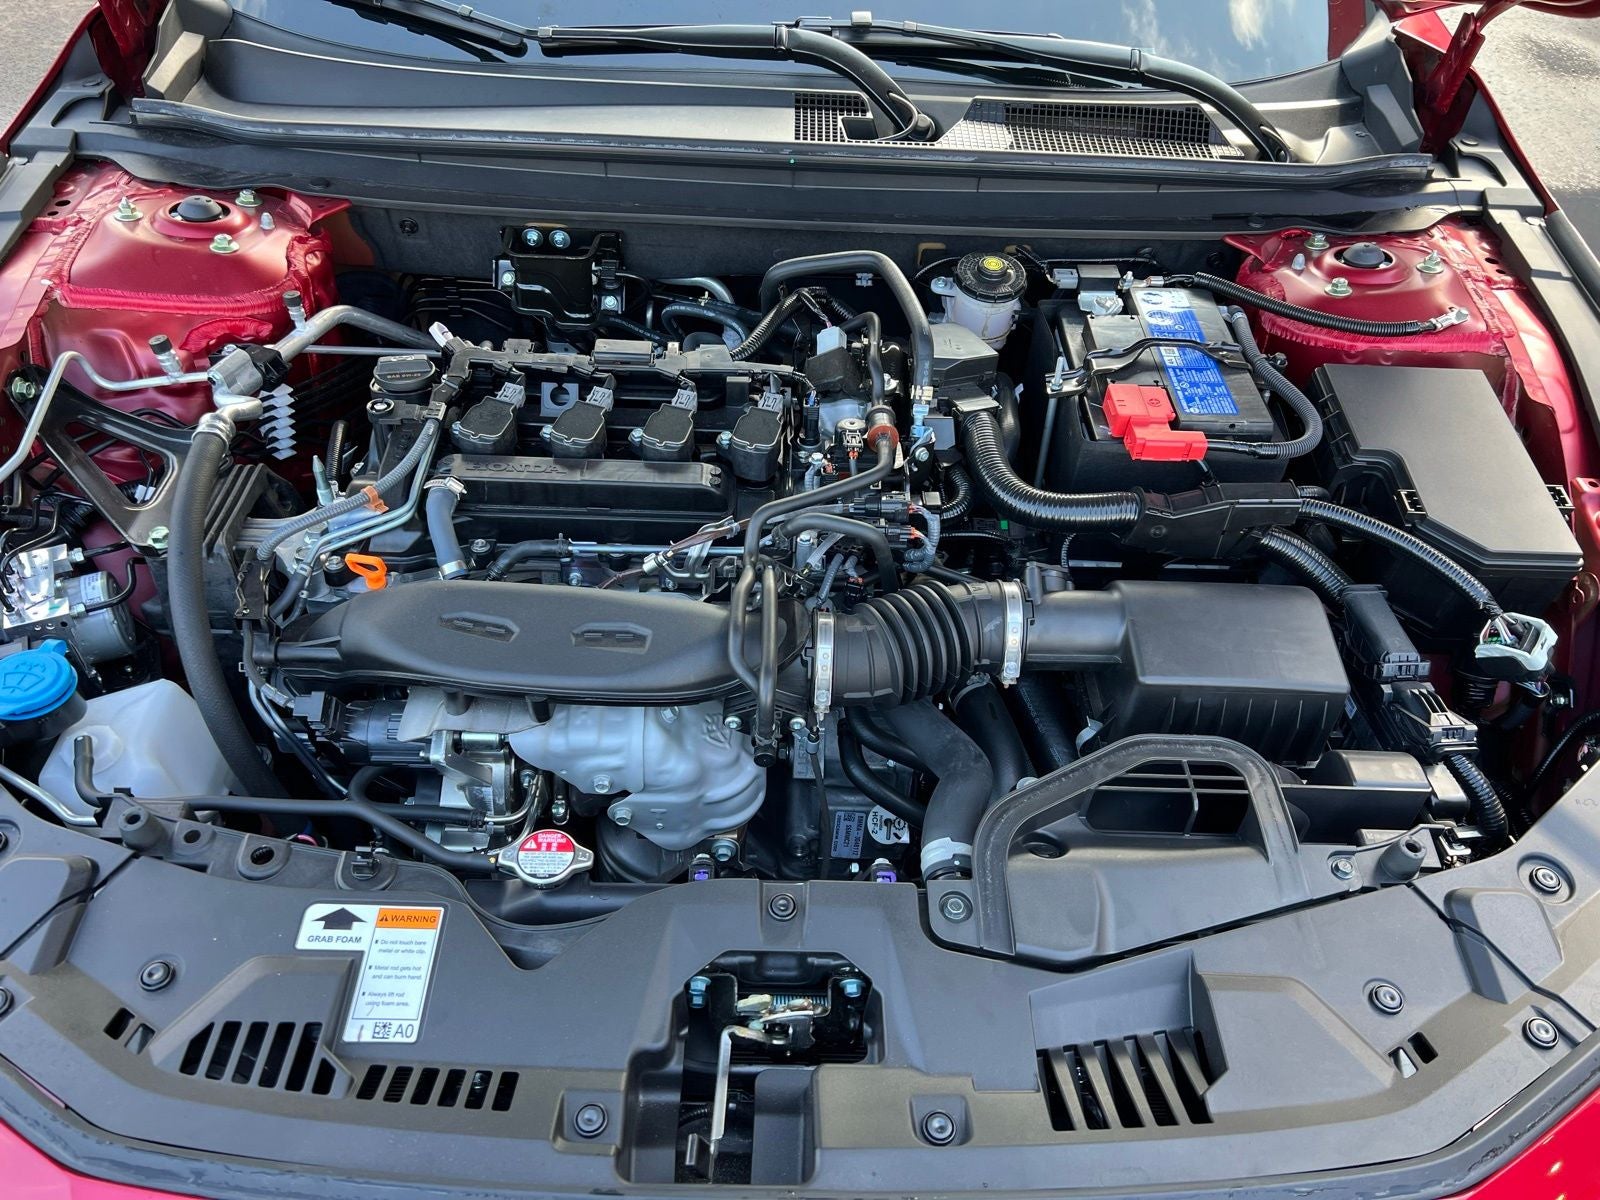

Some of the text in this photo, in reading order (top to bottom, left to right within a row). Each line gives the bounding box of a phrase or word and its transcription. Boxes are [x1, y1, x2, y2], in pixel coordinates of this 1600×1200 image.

[465, 462, 567, 474] HONDA
[871, 811, 879, 835] HCF-2
[391, 915, 437, 924] WARNING
[307, 935, 362, 944] GRAB FOAM
[393, 1023, 414, 1039] A0
